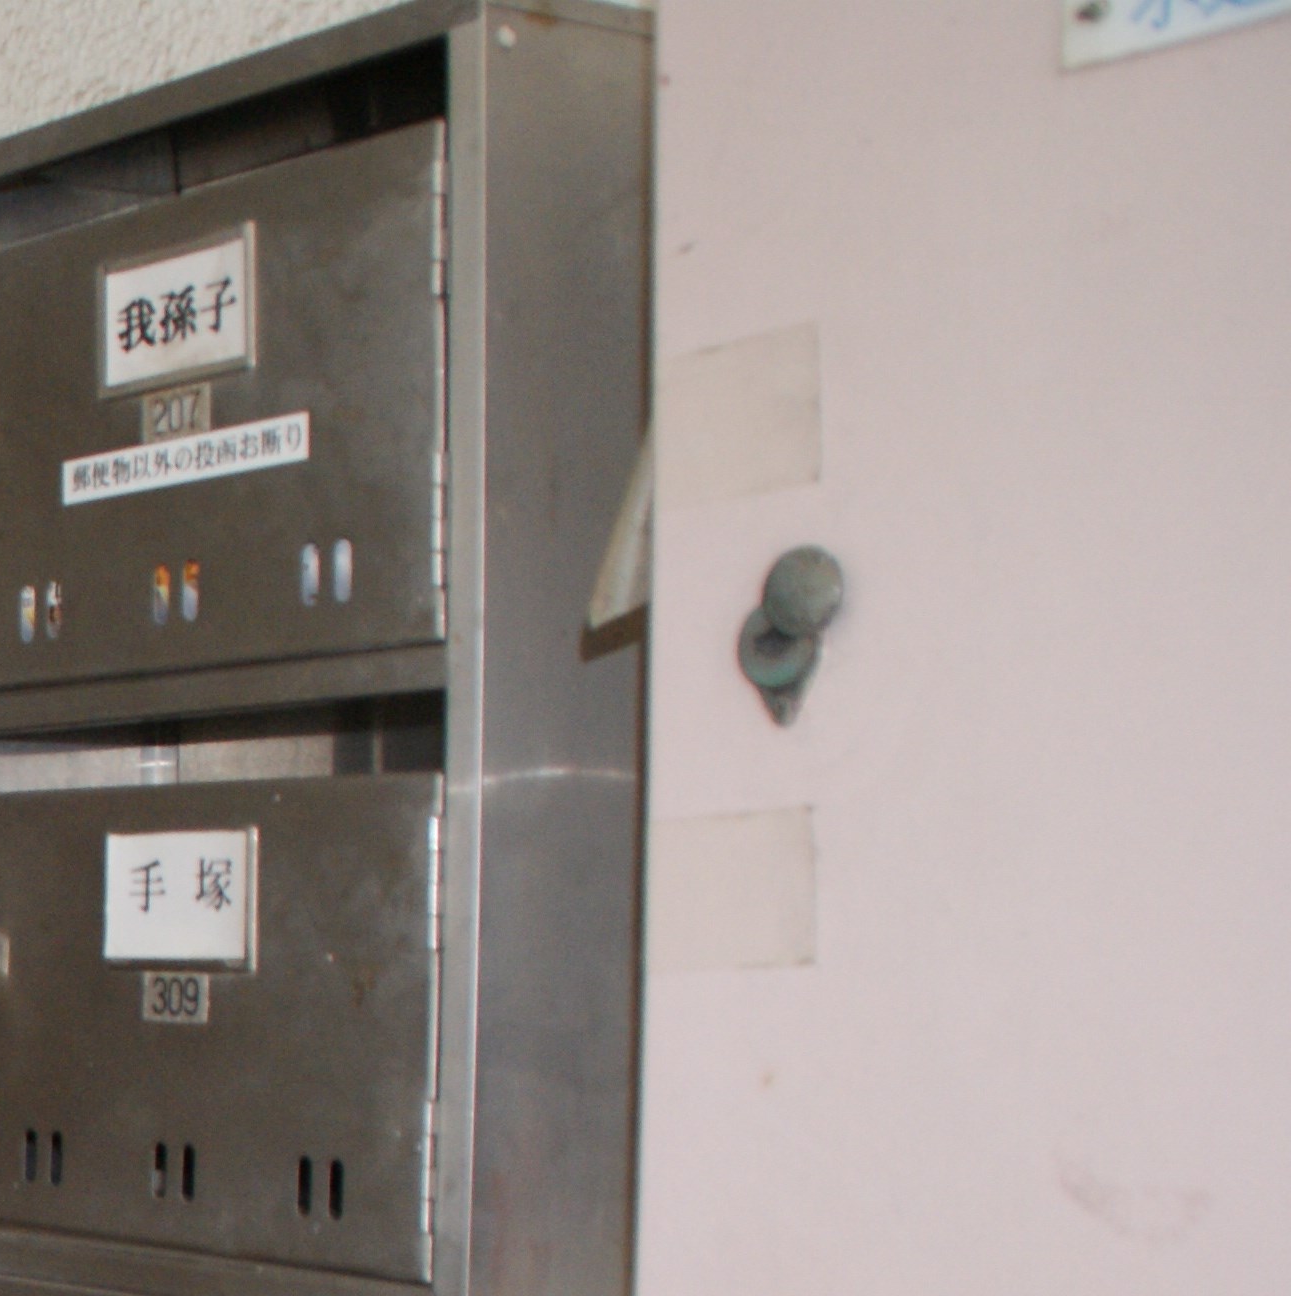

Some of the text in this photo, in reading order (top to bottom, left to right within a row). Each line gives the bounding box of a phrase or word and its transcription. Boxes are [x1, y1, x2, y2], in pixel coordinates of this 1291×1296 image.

[116, 277, 239, 352] 我孫子
[71, 422, 304, 494] 郵便物以外の投函お断り
[129, 857, 233, 913] 手塚
[151, 977, 200, 1016] 309
